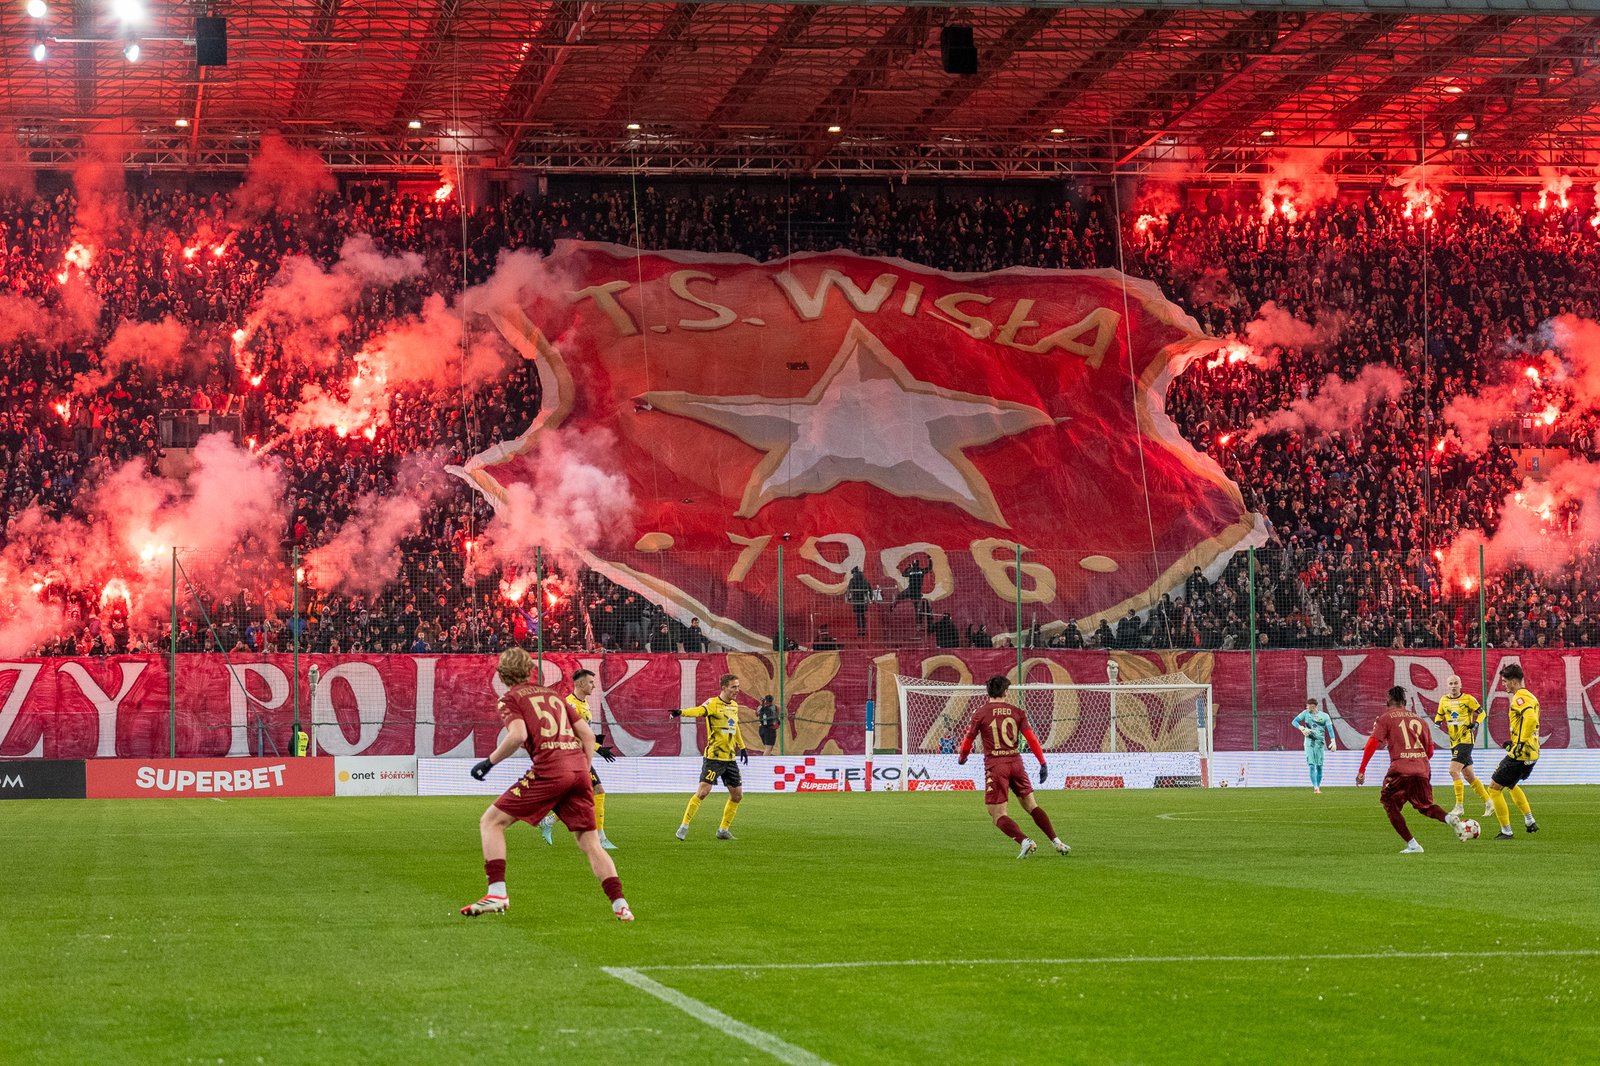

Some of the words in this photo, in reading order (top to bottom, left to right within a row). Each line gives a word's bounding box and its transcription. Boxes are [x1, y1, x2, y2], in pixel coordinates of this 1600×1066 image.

[772, 268, 1122, 368] WISŁA
[726, 532, 1057, 604] 1906
[529, 695, 575, 737] 52
[992, 707, 1012, 716] FRED
[989, 717, 1018, 749] 10
[1398, 719, 1425, 750] 12
[136, 764, 286, 793] SUPERBET
[352, 771, 375, 780] onet
[705, 769, 716, 781] 20
[825, 766, 931, 780] TEXOM
[0, 774, 24, 788] M
[801, 781, 838, 791] SUPERBE
[916, 781, 957, 791] Betclic
